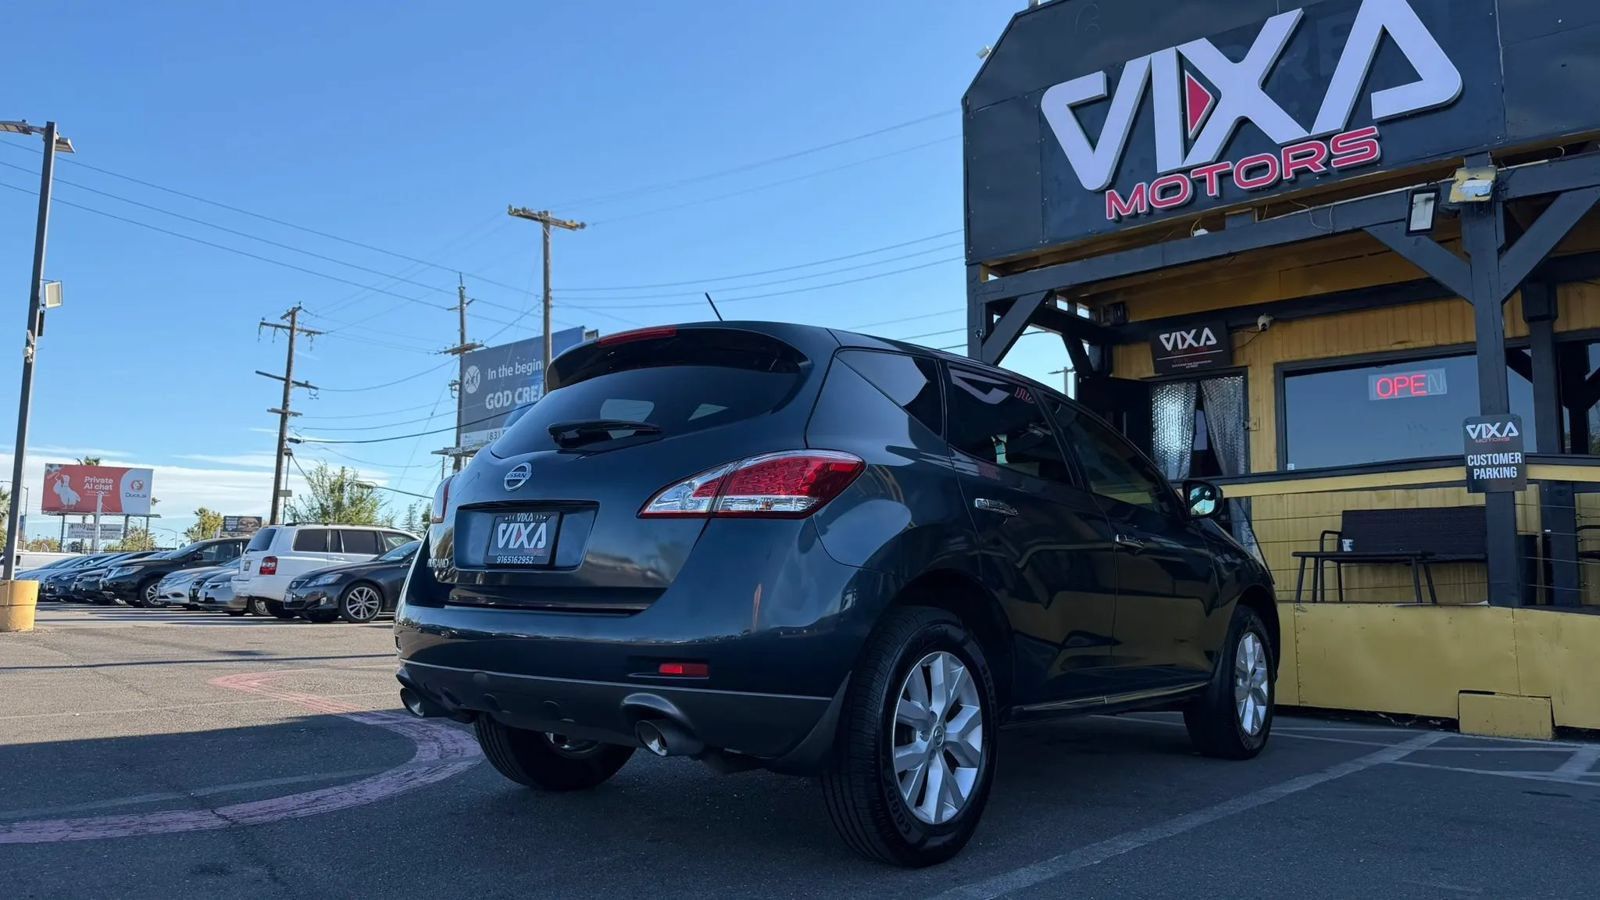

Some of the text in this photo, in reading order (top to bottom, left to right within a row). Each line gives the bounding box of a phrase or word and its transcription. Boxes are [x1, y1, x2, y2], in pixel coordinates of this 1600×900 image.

[1041, 0, 1462, 191] VIXA
[1105, 125, 1382, 221] MOTORS
[1159, 327, 1218, 352] VIXA
[488, 368, 496, 380] In
[498, 364, 513, 378] the
[1376, 371, 1443, 398] OPEN
[485, 389, 512, 410] GOD
[1466, 421, 1519, 440] VIXA
[1467, 452, 1522, 467] CUSTOMER
[83, 476, 114, 485] Private
[1473, 467, 1518, 480] PARKING
[94, 483, 113, 491] chat
[517, 512, 534, 522] VIXA
[497, 522, 547, 549] VIXA
